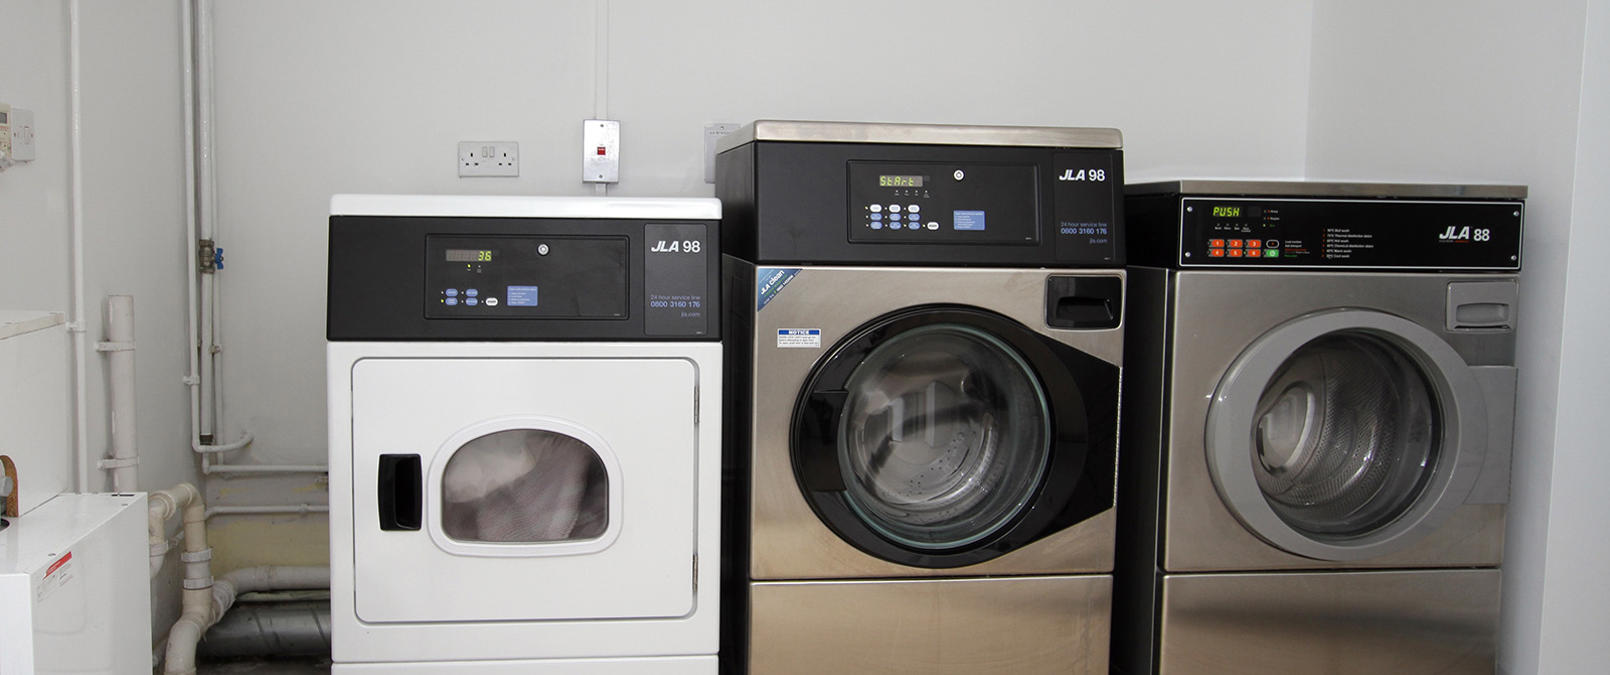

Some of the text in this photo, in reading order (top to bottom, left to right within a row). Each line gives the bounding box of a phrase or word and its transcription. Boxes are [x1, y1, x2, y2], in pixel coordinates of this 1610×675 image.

[1059, 169, 1105, 181] JLA 98
[1213, 206, 1240, 217] PUSH
[1439, 226, 1490, 241] JLA 88
[651, 240, 701, 253] JLA 98
[478, 250, 492, 261] 36
[761, 283, 770, 295] JLA
[769, 270, 785, 286] clean
